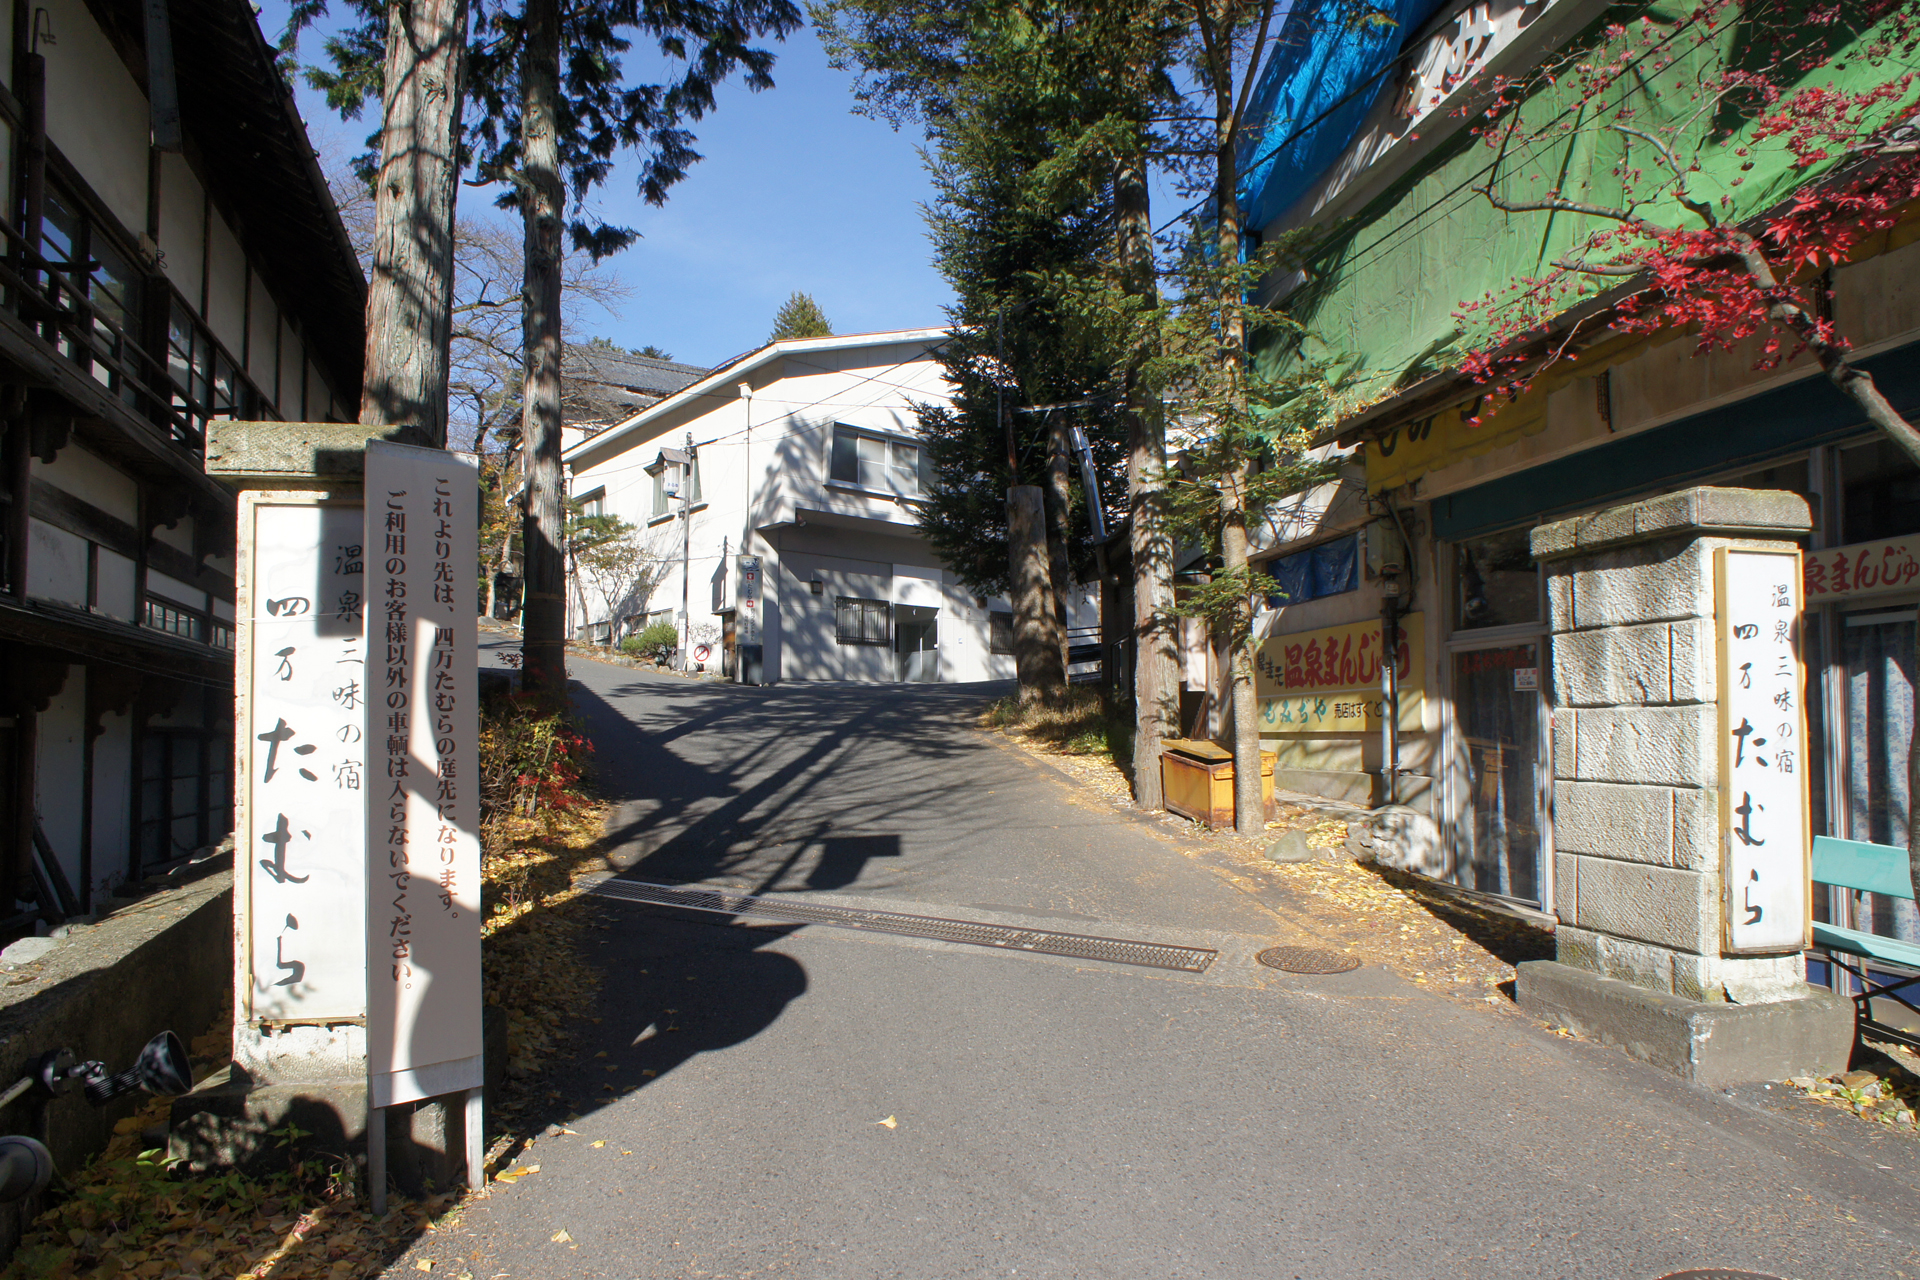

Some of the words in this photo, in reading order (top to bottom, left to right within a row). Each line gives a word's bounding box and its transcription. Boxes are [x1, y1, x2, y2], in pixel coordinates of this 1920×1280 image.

[257, 596, 320, 987] 四万たむら
[433, 477, 458, 919] これより先は、四万たむらの庭先になります。
[1284, 628, 1411, 690] 温泉まんじう
[1732, 622, 1768, 926] 四万たむら
